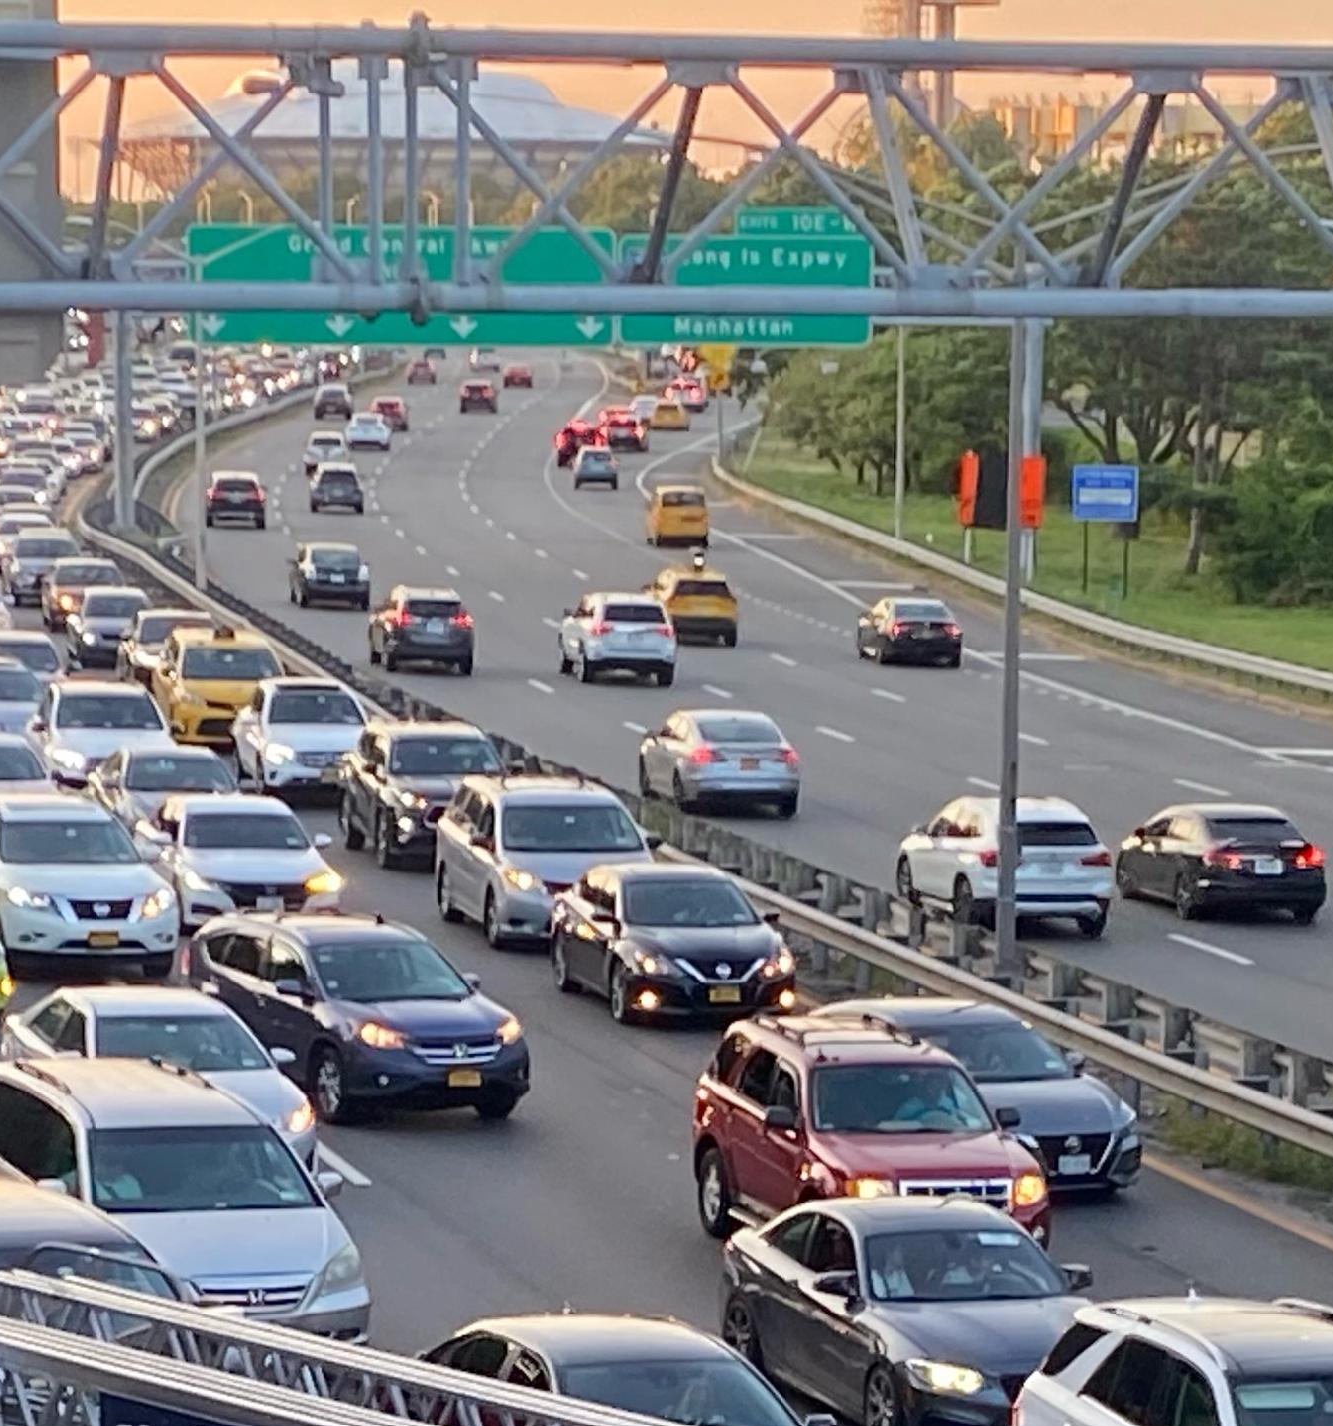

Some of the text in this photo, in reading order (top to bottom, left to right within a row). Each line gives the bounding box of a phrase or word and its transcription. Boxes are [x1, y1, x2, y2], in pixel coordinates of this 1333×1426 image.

[683, 247, 847, 270] ong Is Expwy
[674, 317, 794, 337] Manhattan
